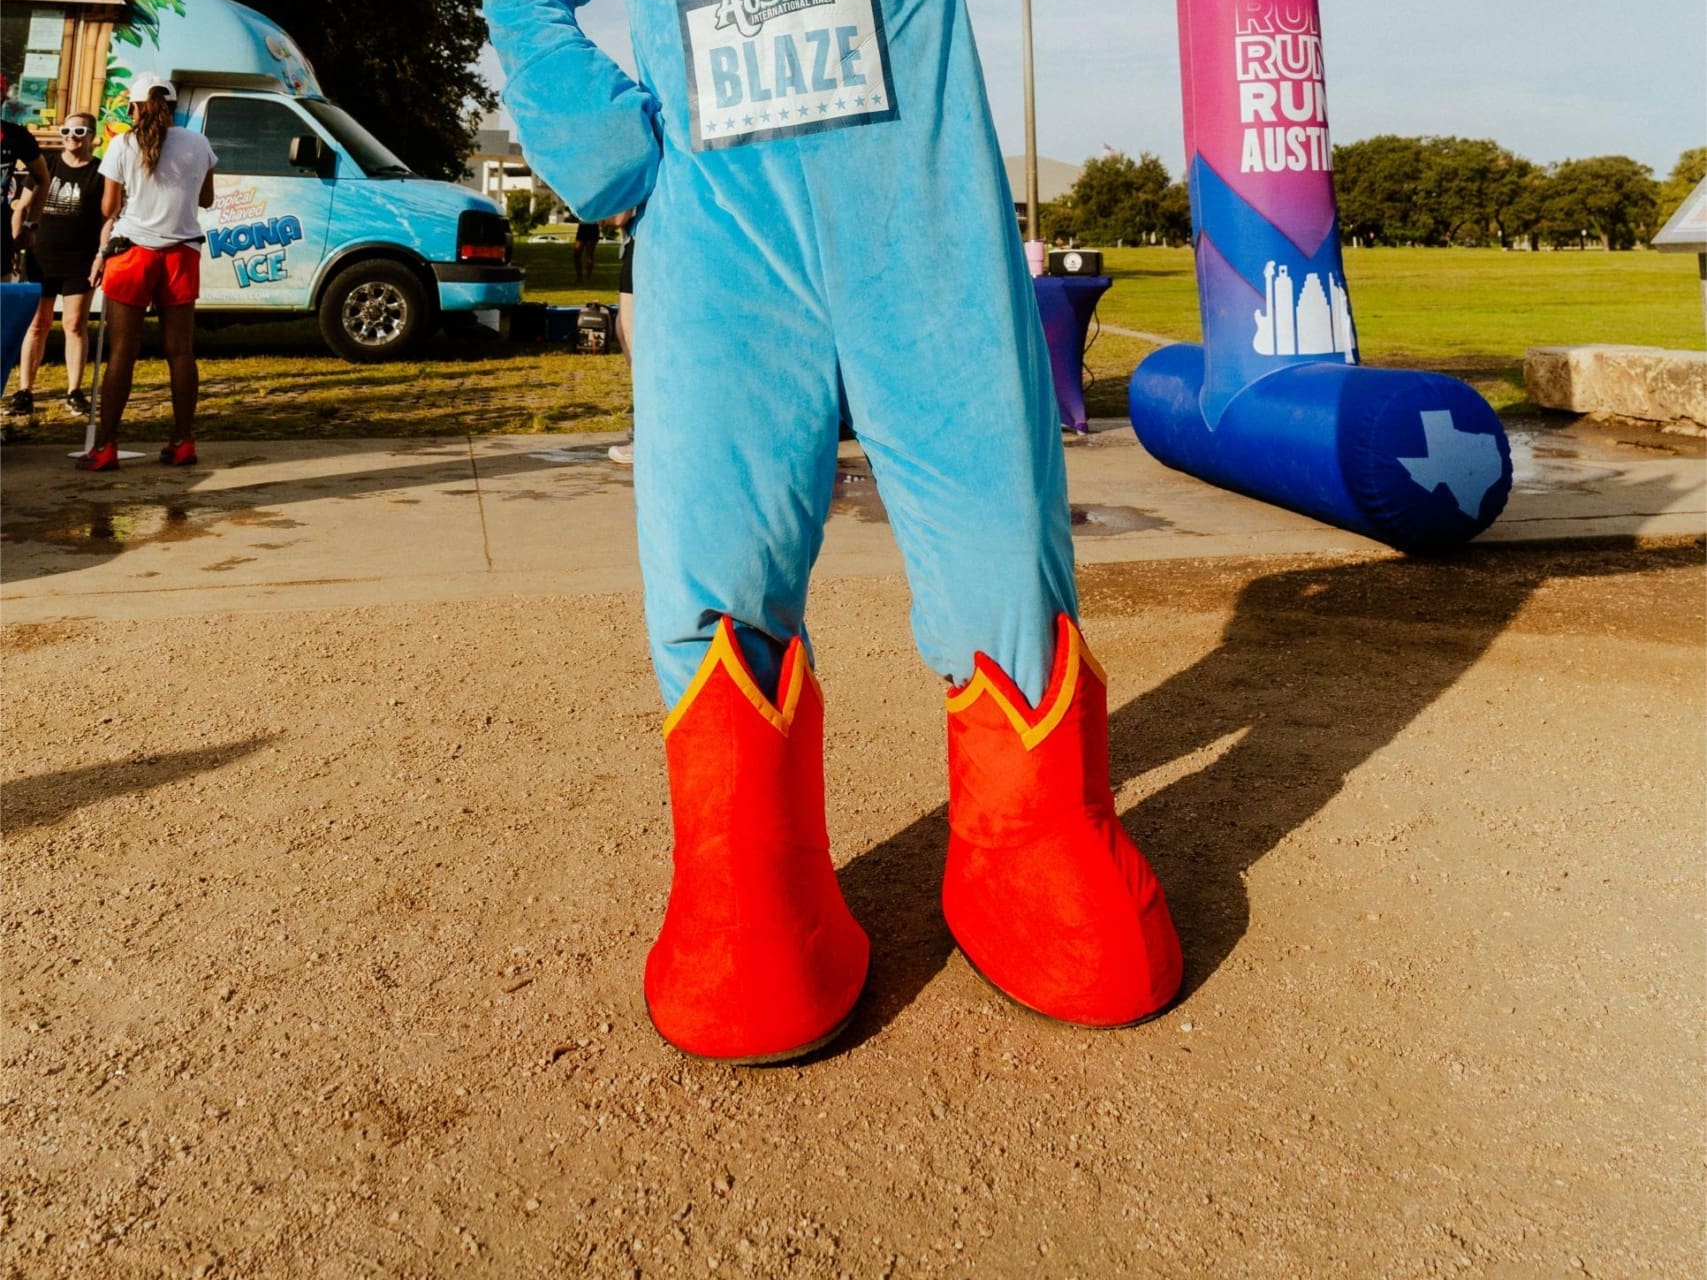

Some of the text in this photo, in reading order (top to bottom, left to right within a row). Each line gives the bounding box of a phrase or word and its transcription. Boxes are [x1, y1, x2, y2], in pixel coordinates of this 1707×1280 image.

[709, 25, 867, 109] BLAZE
[219, 197, 267, 224] Shaved
[207, 215, 302, 259] KONA
[232, 248, 288, 288] ICE
